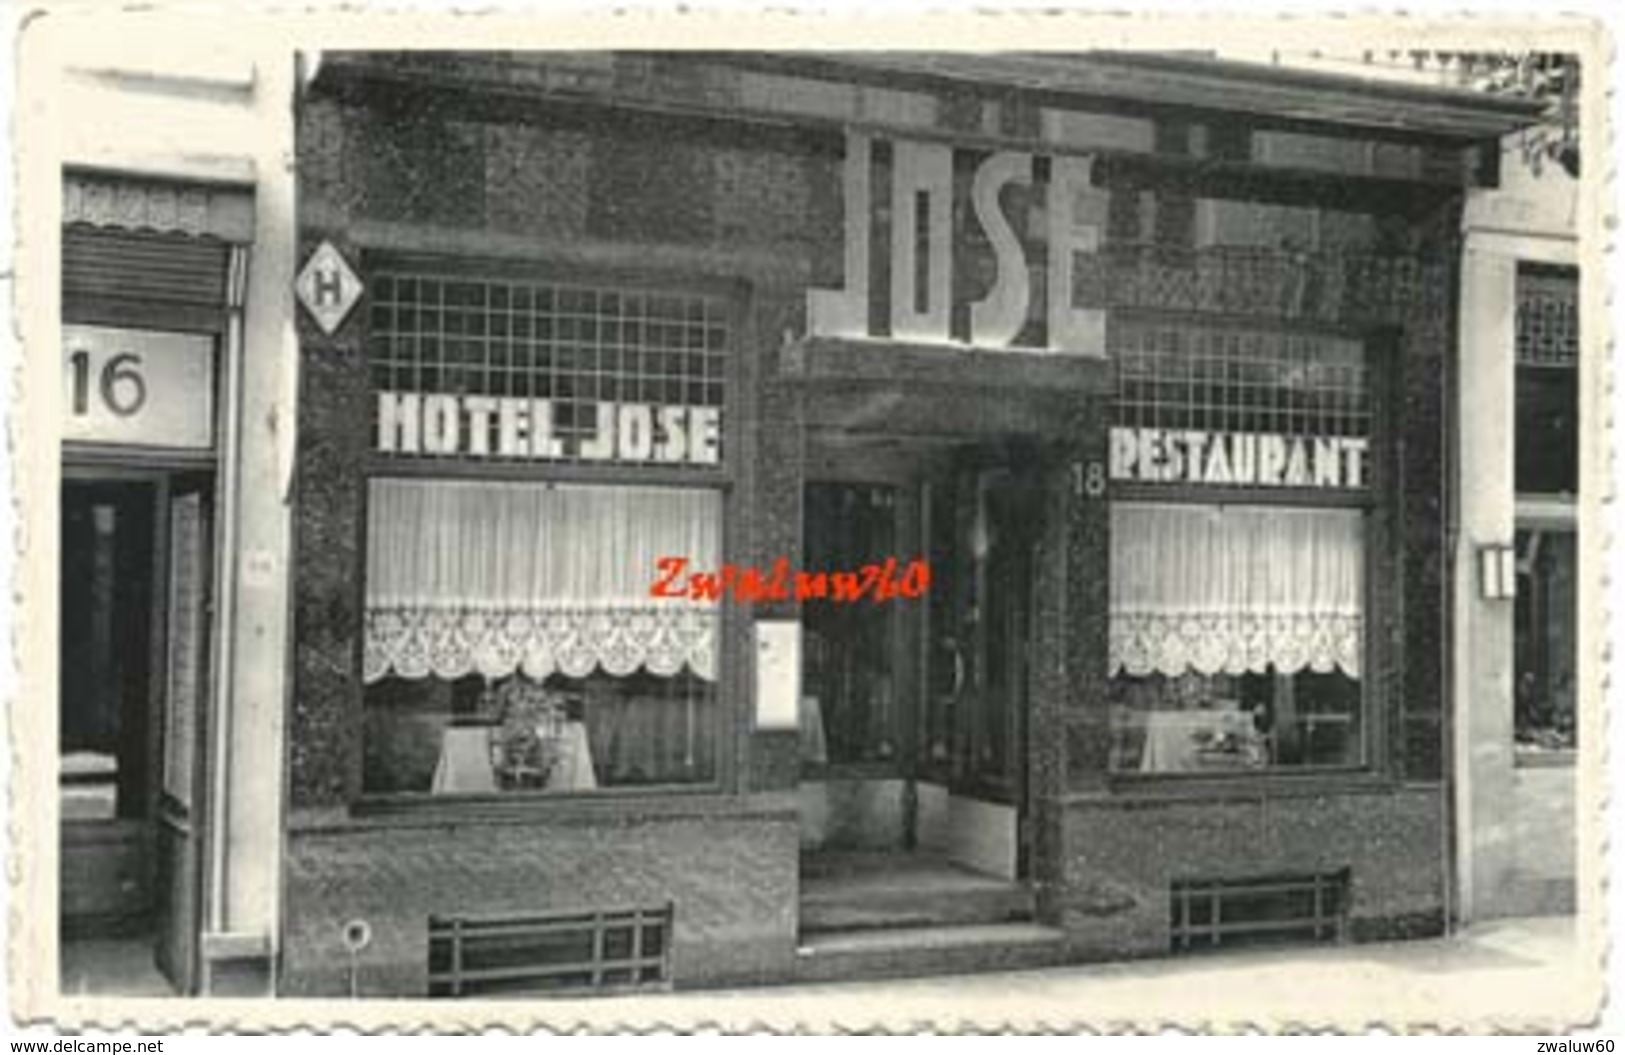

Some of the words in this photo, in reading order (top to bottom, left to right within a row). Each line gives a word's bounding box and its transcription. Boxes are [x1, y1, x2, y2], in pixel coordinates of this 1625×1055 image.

[806, 127, 1107, 358] JOSE
[314, 270, 341, 306] H
[71, 350, 146, 418] 16
[378, 391, 562, 457] HOTEL
[580, 401, 719, 464] JOSE
[1108, 427, 1368, 487] RESTAURANT
[1072, 461, 1106, 495] 18
